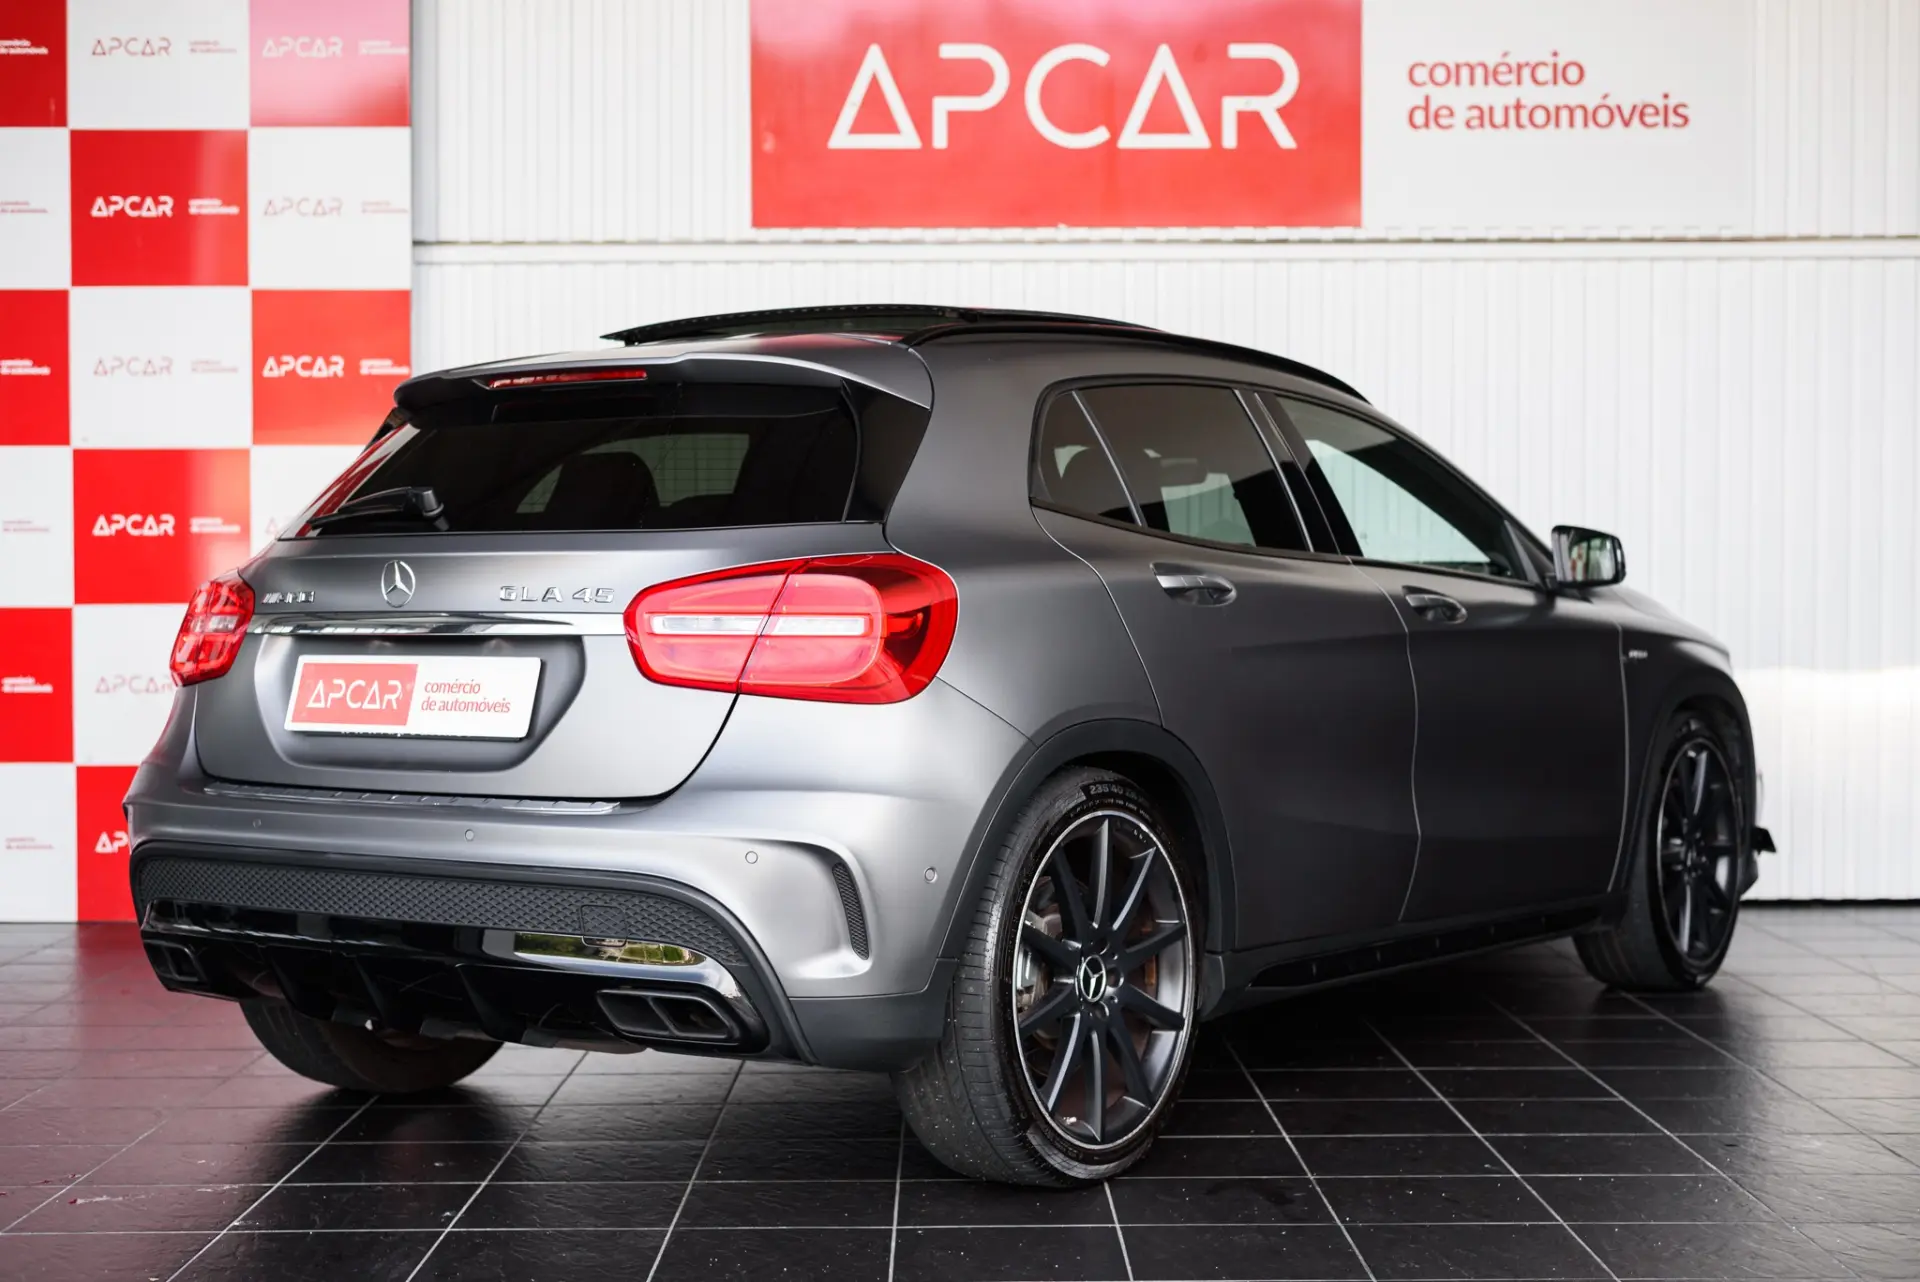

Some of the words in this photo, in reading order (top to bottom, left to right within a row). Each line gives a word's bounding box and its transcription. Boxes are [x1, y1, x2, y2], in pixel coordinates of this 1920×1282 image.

[91, 36, 172, 56] APCAR
[262, 36, 343, 58] APCAR
[1408, 51, 1585, 87] comércio
[827, 43, 1299, 150] APCAR
[1408, 94, 1455, 129] de
[1465, 92, 1690, 129] automóveis
[90, 195, 174, 218] APCAR
[263, 196, 343, 217] APCAR
[93, 356, 173, 376] APCAR
[262, 355, 344, 378] APCAR
[92, 513, 175, 536] APCAR
[499, 585, 563, 602] GLA
[572, 587, 615, 603] 45
[306, 679, 402, 709] APCAR
[424, 679, 481, 694] comércio
[421, 696, 436, 711] de
[438, 697, 511, 713] automóveis
